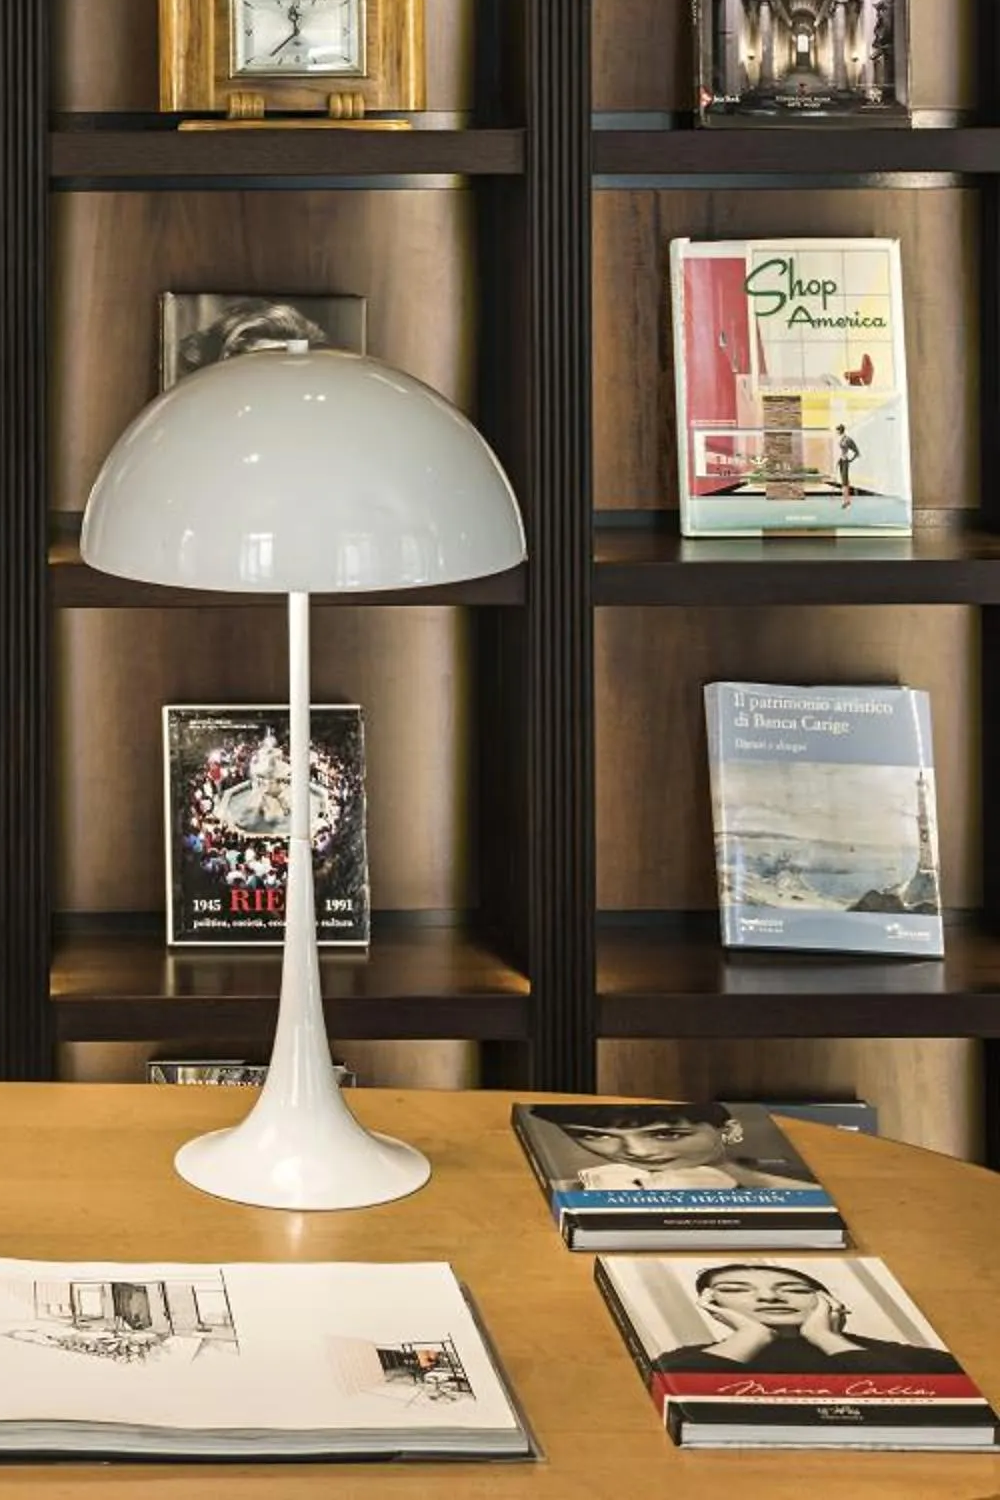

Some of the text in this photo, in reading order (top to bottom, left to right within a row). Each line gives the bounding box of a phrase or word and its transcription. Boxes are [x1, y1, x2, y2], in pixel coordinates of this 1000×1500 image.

[743, 256, 838, 317] Shop
[786, 305, 888, 329] America
[734, 692, 893, 714] Il patrimonio artistico
[734, 711, 749, 727] di
[753, 713, 797, 729] Banca
[193, 899, 221, 911] 1945
[229, 888, 285, 912] RIE
[325, 899, 353, 911] 1991
